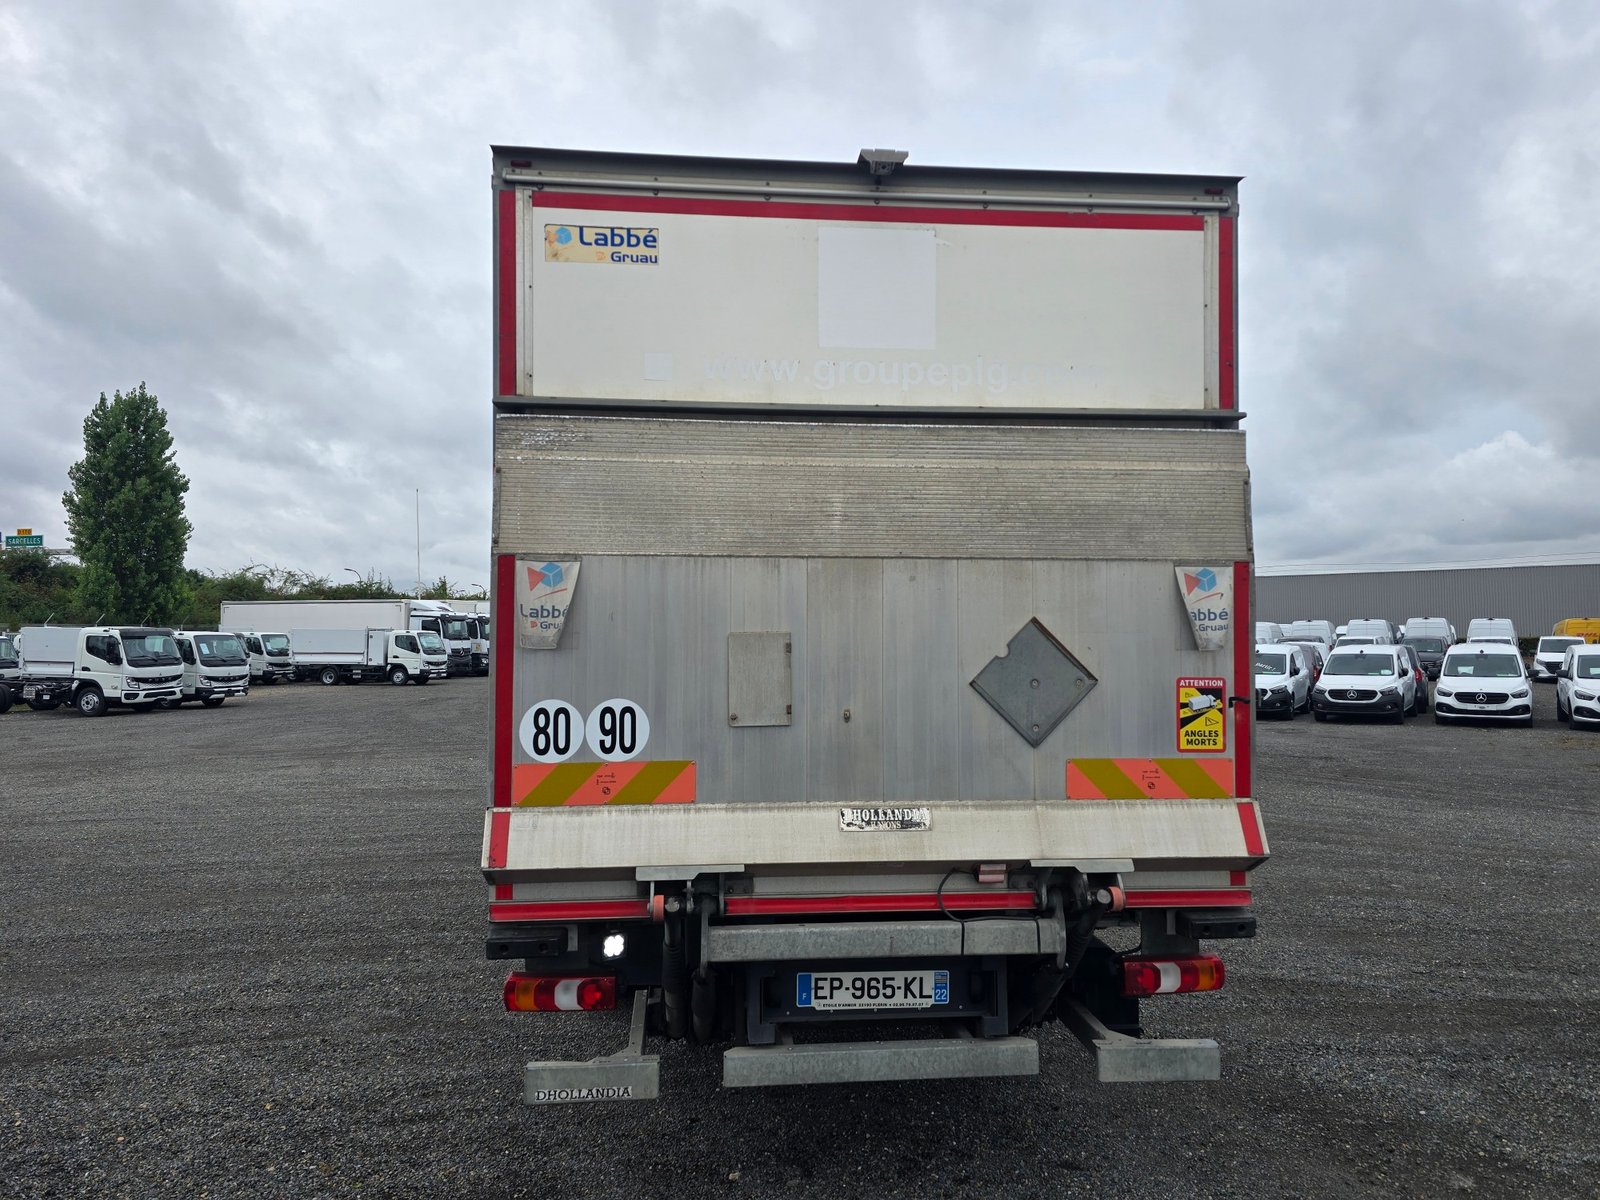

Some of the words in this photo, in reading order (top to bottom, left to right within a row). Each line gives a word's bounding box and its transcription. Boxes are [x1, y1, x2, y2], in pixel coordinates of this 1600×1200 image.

[578, 226, 658, 248] Labbé
[610, 251, 658, 264] Gruau
[1190, 608, 1229, 621] abbé
[1198, 623, 1229, 632] Gruau
[533, 707, 571, 756] 80
[599, 706, 637, 755] 90
[1184, 730, 1219, 738] ANGLES
[814, 977, 933, 1000] EP-965-KL
[935, 989, 947, 1000] 22
[536, 1087, 631, 1101] DHOLLANDIA
